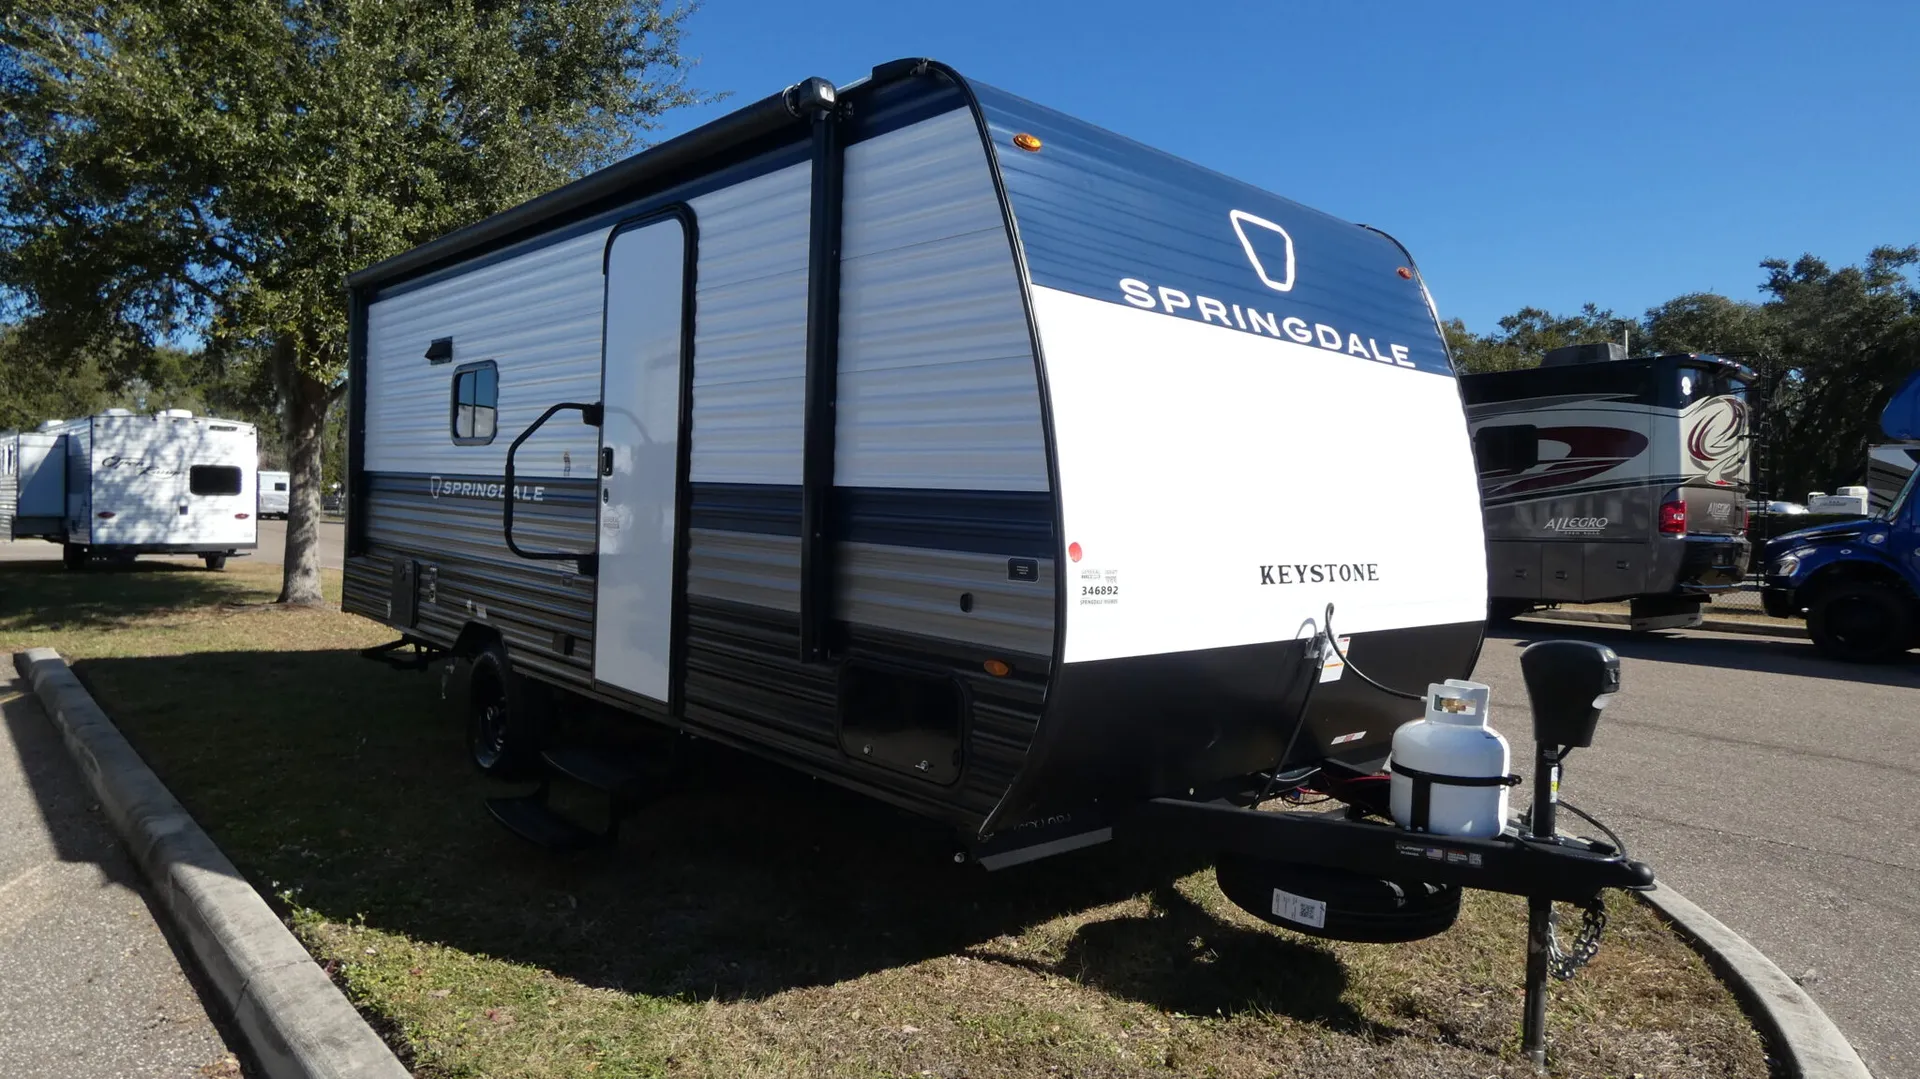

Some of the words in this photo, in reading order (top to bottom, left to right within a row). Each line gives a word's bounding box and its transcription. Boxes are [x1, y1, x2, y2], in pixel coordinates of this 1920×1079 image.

[1119, 277, 1416, 368] SPRINGDALE
[1543, 517, 1608, 531] ALLEGRO
[1260, 564, 1379, 585] KEYSTONE
[1081, 585, 1119, 596] 346892
